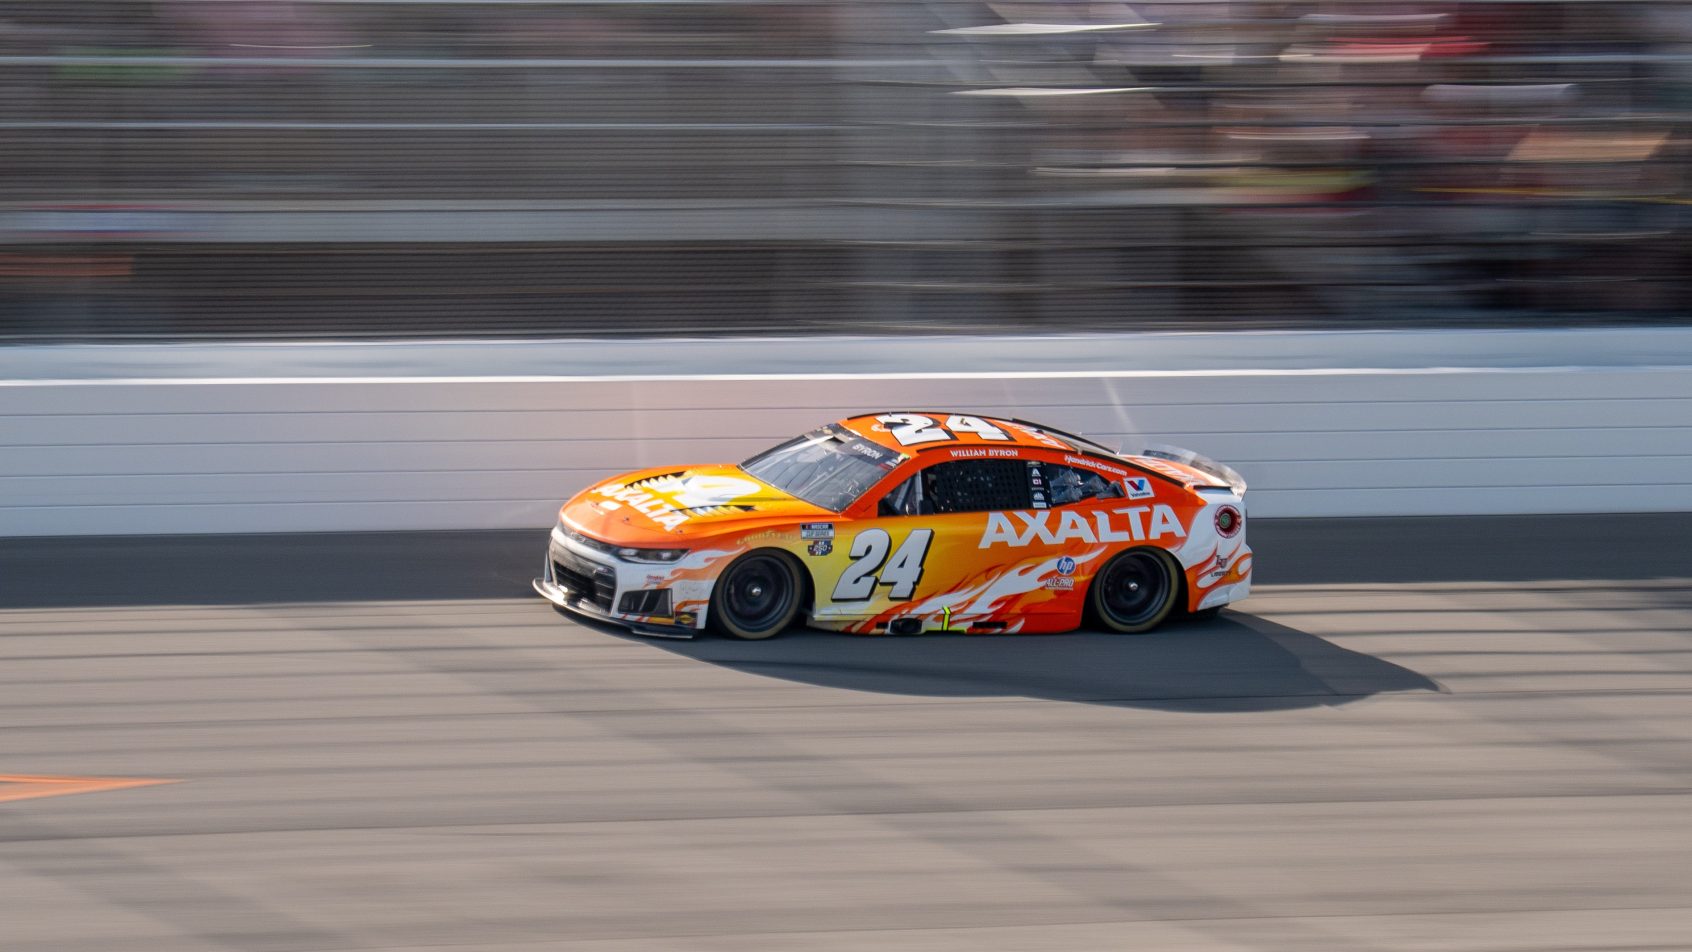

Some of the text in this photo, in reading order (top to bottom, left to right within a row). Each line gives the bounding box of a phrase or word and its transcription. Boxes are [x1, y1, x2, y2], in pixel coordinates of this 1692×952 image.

[875, 413, 1016, 446] 24
[852, 443, 884, 460] BYRON
[950, 449, 1019, 457] WILLIAM BYRON
[978, 504, 1187, 549] AXALTA
[831, 528, 934, 602] 24
[1059, 556, 1074, 574] hp
